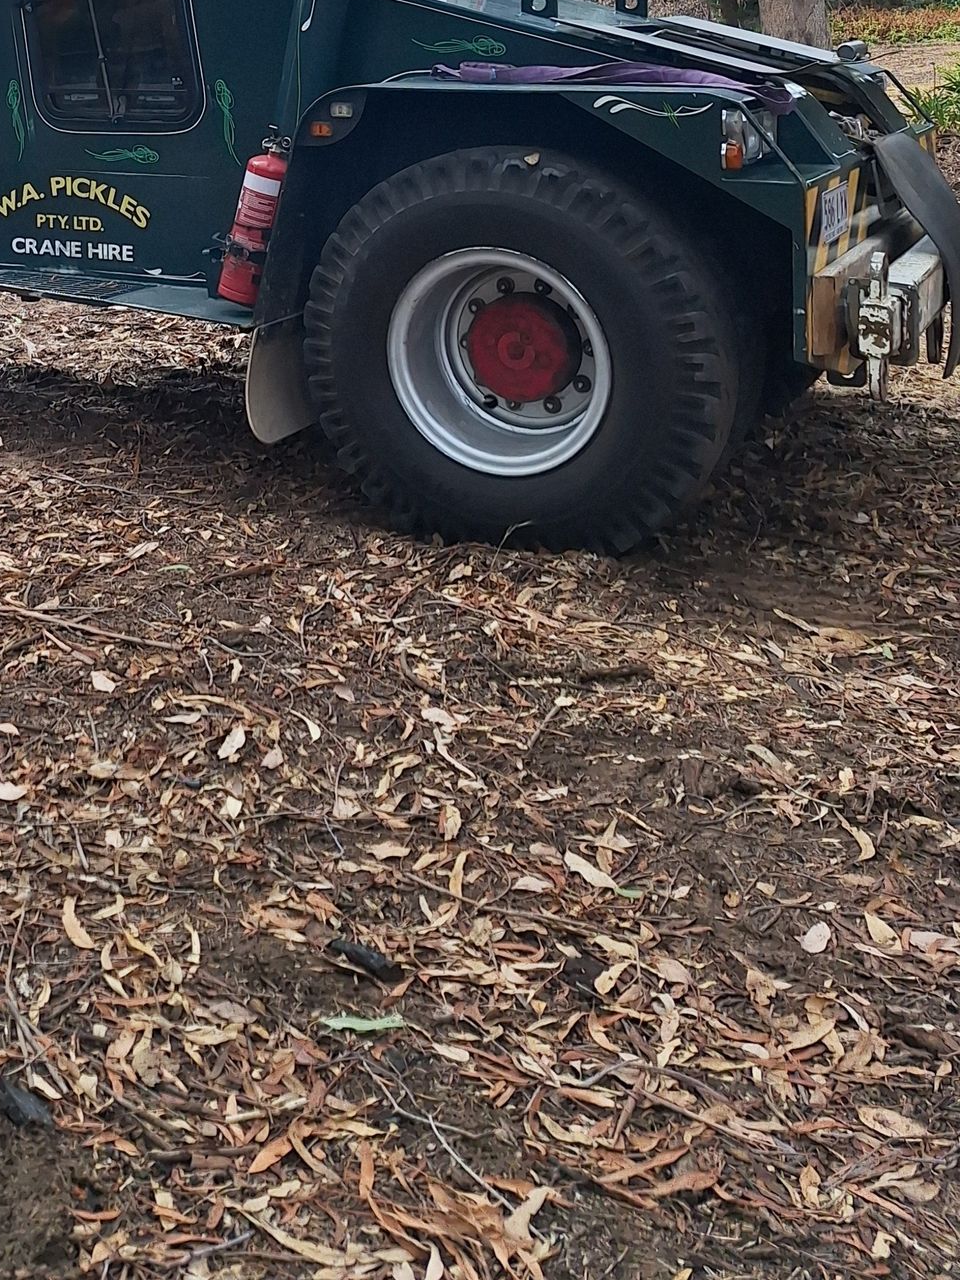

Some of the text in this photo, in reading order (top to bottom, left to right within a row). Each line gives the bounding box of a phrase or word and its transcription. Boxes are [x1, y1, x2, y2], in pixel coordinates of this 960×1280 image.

[50, 176, 151, 229] PICKLES
[36, 214, 105, 232] PTY. LTD.
[11, 237, 134, 262] CRANE HIRE
